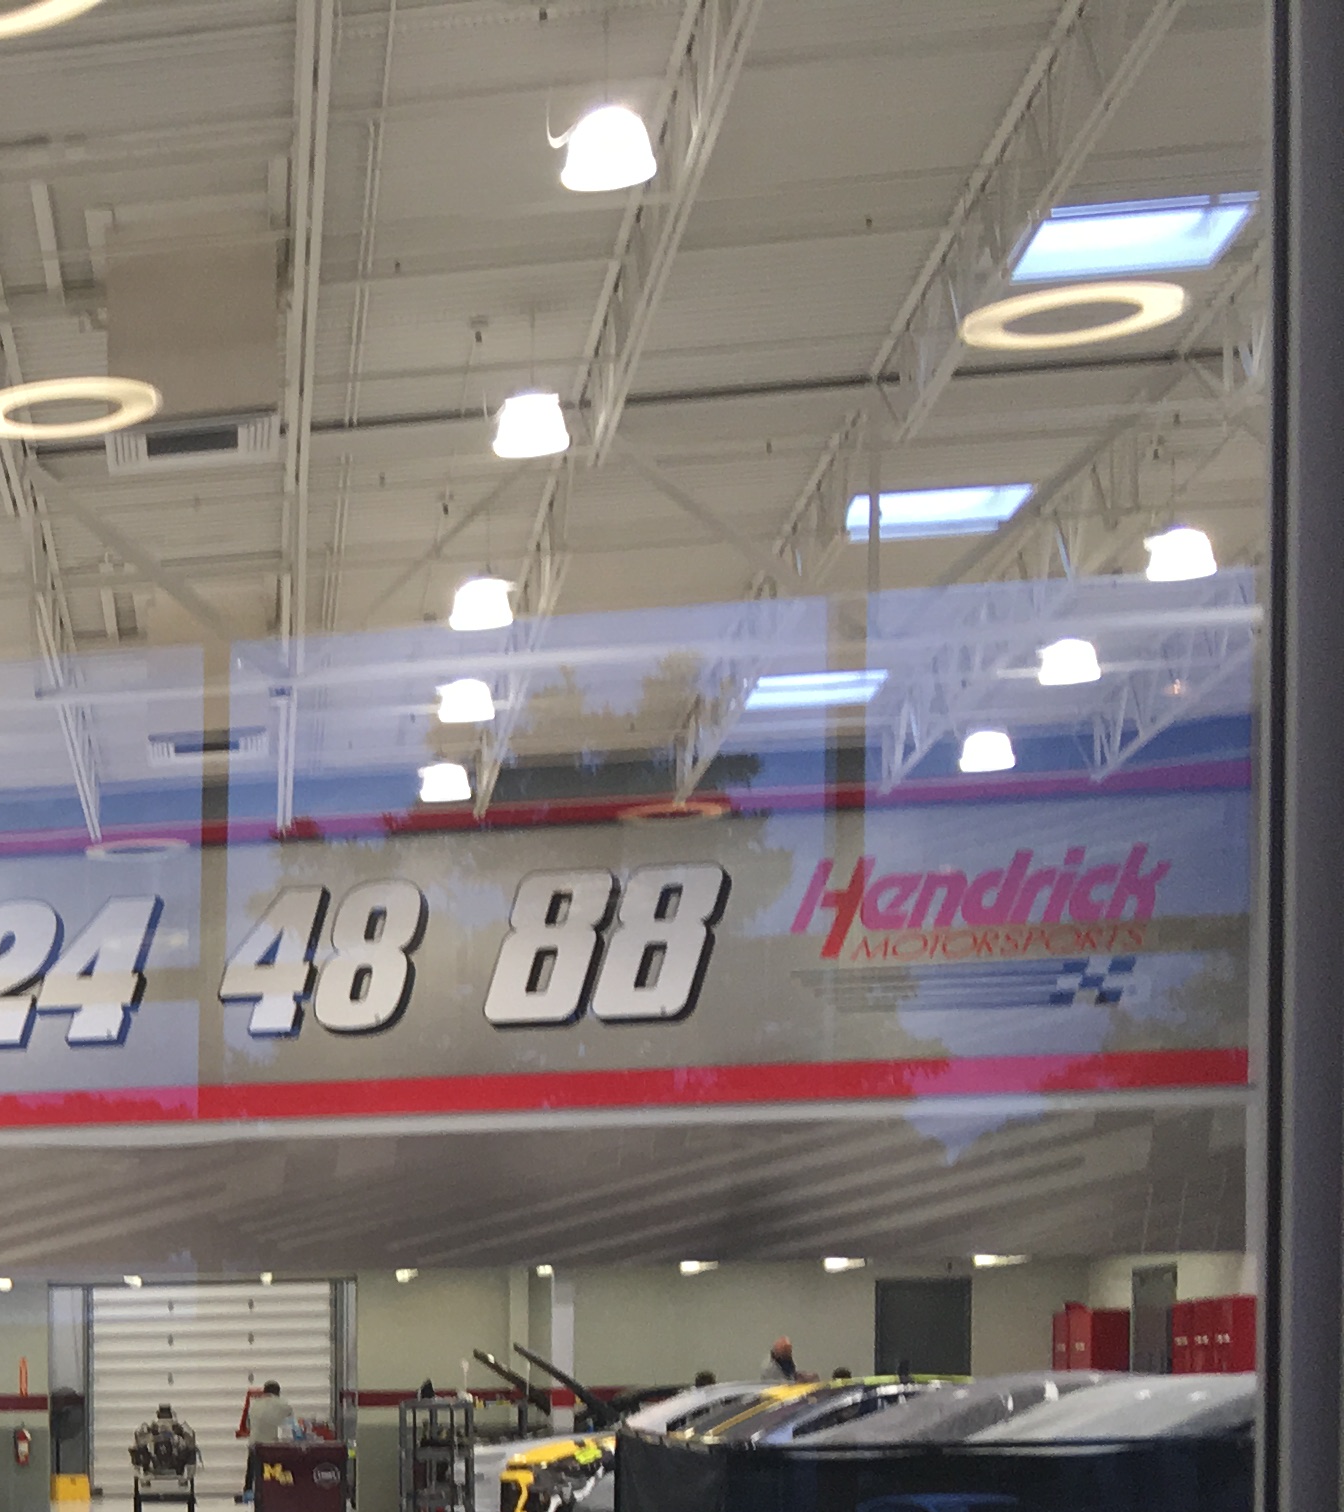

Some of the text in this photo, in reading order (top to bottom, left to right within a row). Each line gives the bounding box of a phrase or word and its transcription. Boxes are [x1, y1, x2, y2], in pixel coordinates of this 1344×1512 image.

[217, 880, 428, 1038] 48
[482, 861, 731, 1028] 88
[791, 842, 1170, 960] Hendrick
[852, 923, 1147, 962] MOTORSPORTS
